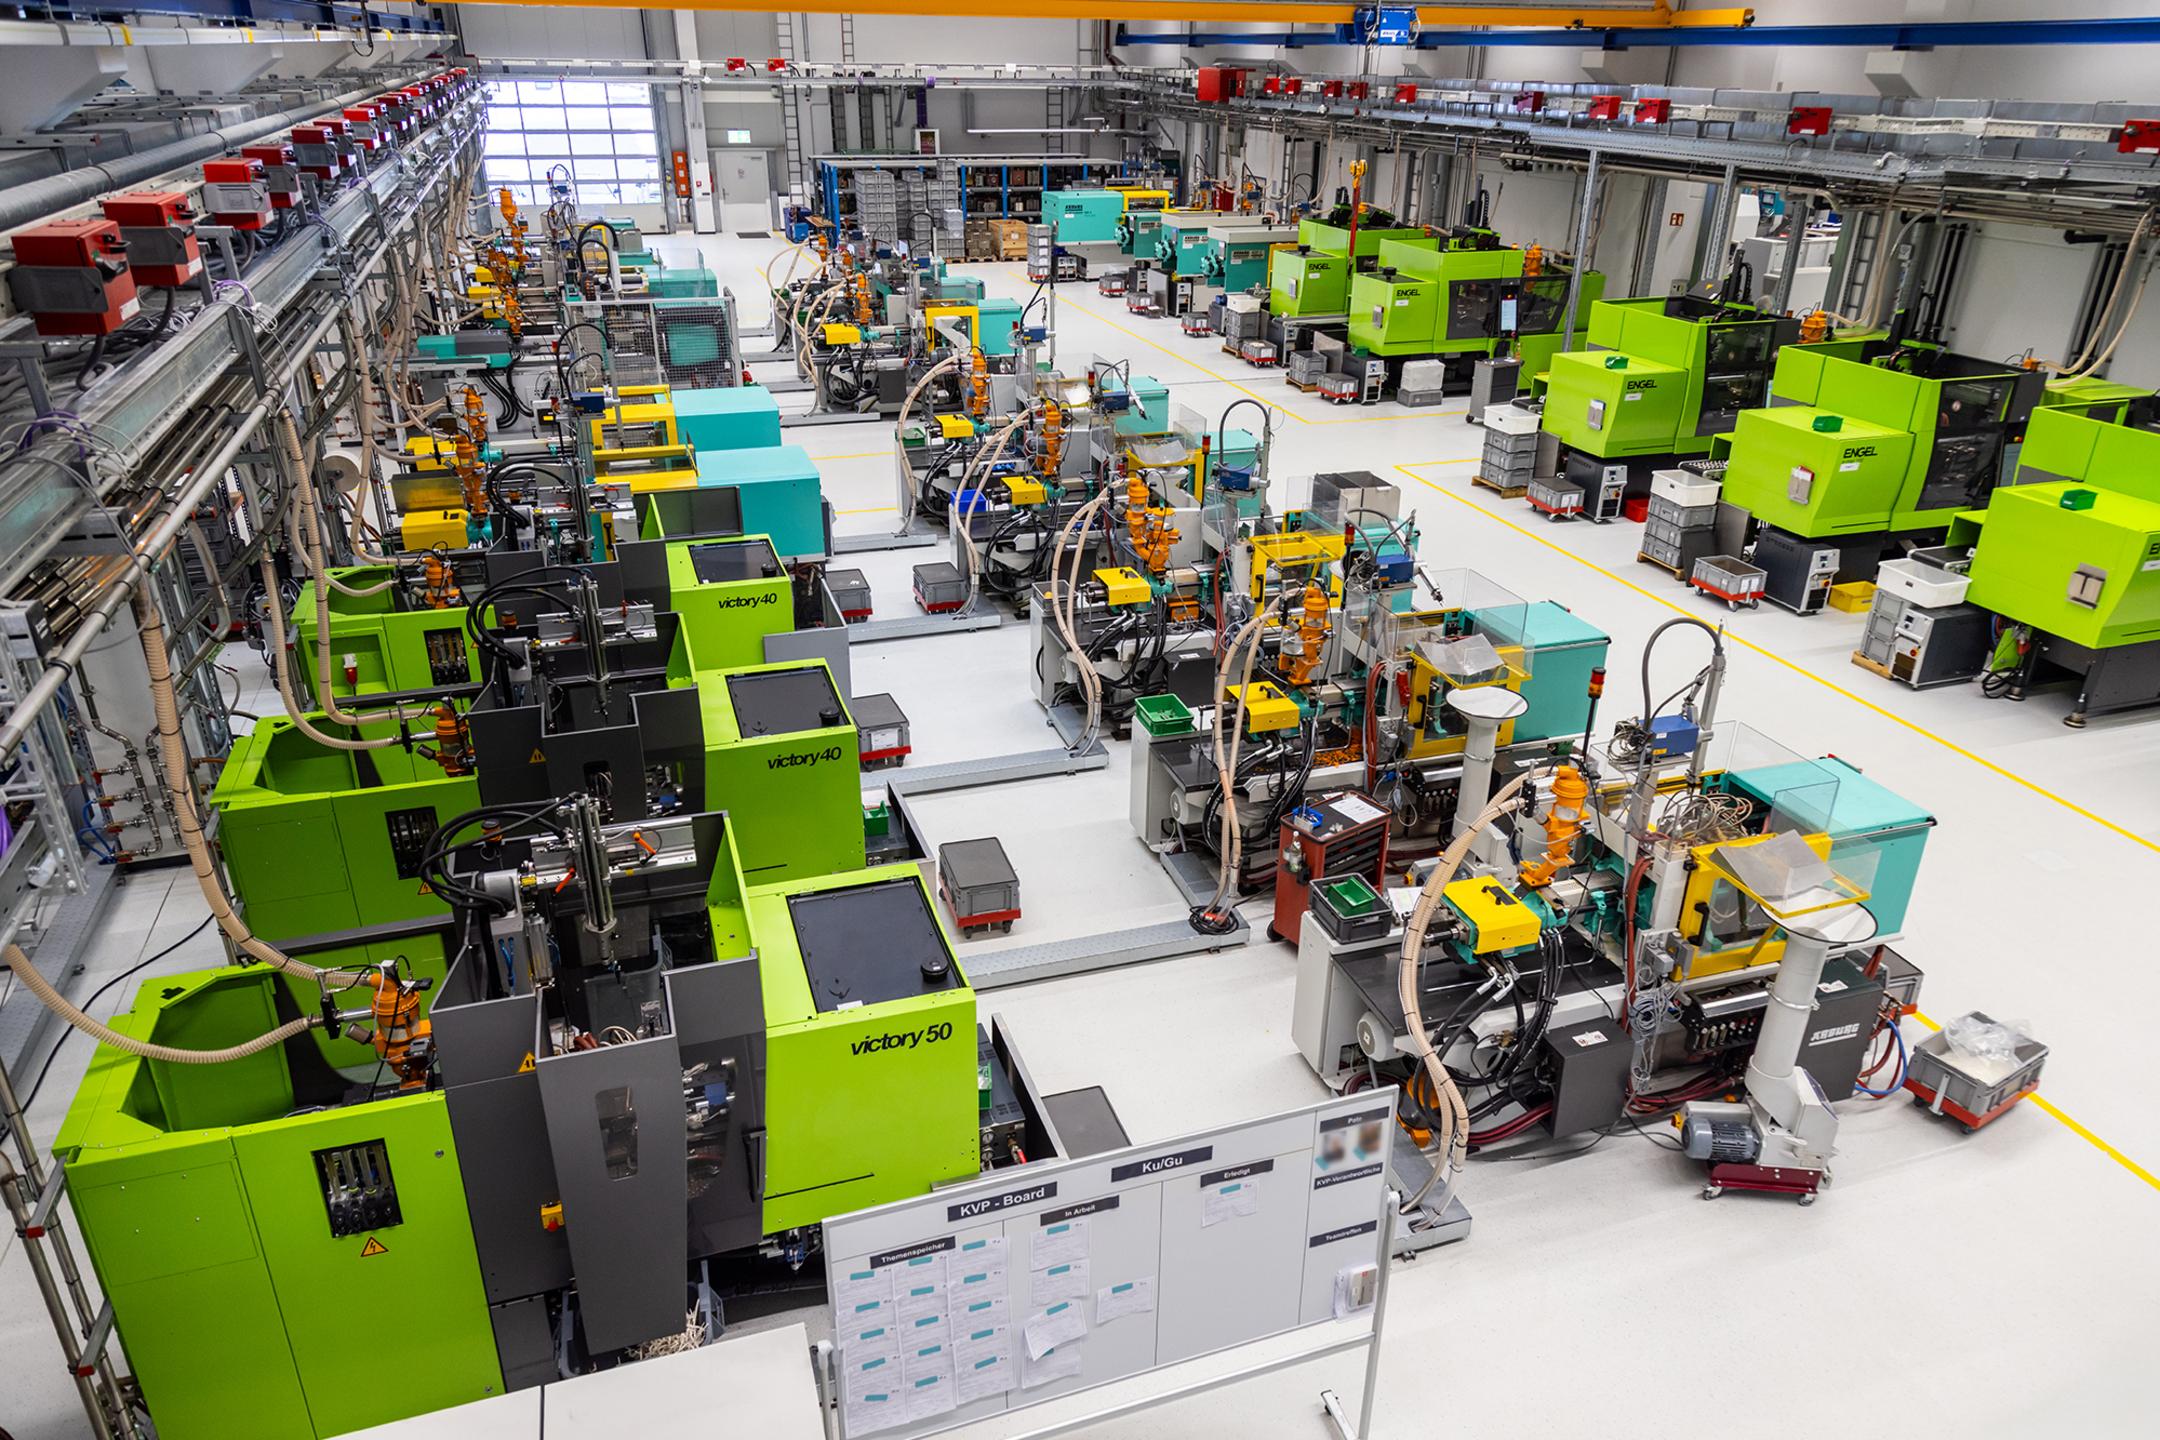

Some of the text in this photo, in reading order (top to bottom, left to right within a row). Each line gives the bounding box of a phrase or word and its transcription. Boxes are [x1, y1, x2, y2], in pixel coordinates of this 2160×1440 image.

[1627, 379, 1657, 390] ENGEL
[1843, 446, 1878, 459] ENGEL
[851, 1022, 953, 1056] victory 50
[1810, 1023, 1860, 1042] ARBURG
[1142, 1155, 1183, 1173] Ku/Gu
[1224, 1168, 1251, 1180] Erledigt
[960, 1199, 991, 1217] KVP
[1003, 1187, 1045, 1207] Board
[1073, 1204, 1096, 1215] Arbeit
[881, 1241, 946, 1263] Themenspeicher
